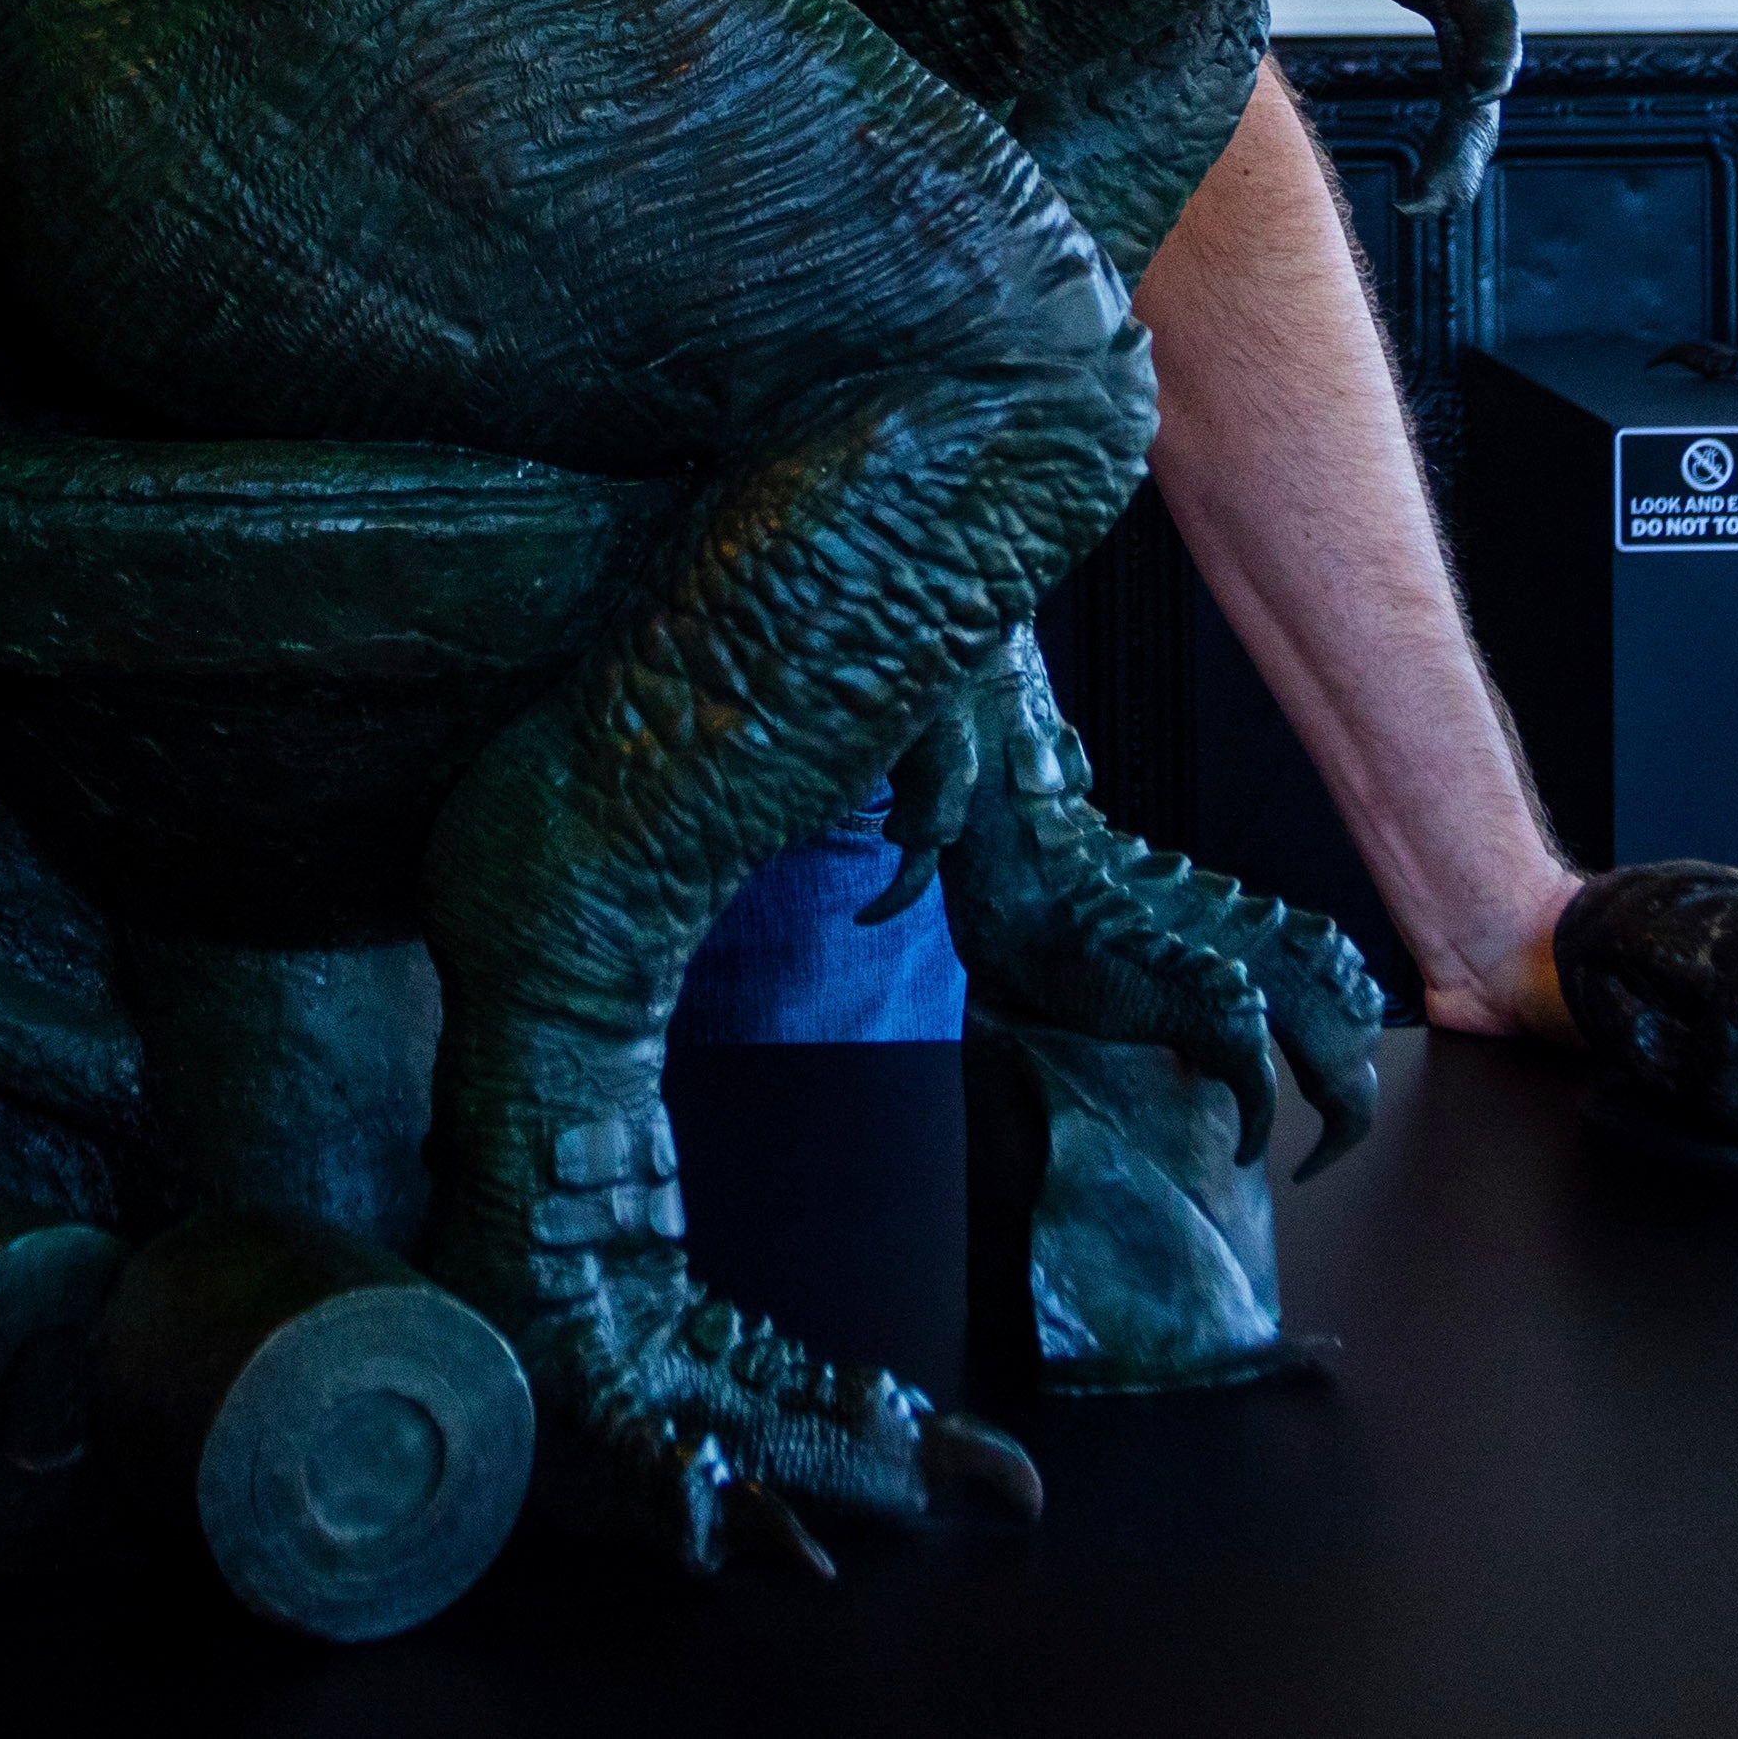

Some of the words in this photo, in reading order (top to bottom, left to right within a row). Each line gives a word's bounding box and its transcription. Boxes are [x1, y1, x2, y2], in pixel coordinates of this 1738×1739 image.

[1630, 496, 1681, 515] LOOK
[1684, 495, 1724, 514] AND
[1631, 517, 1663, 537] DO
[1665, 516, 1711, 536] NOT
